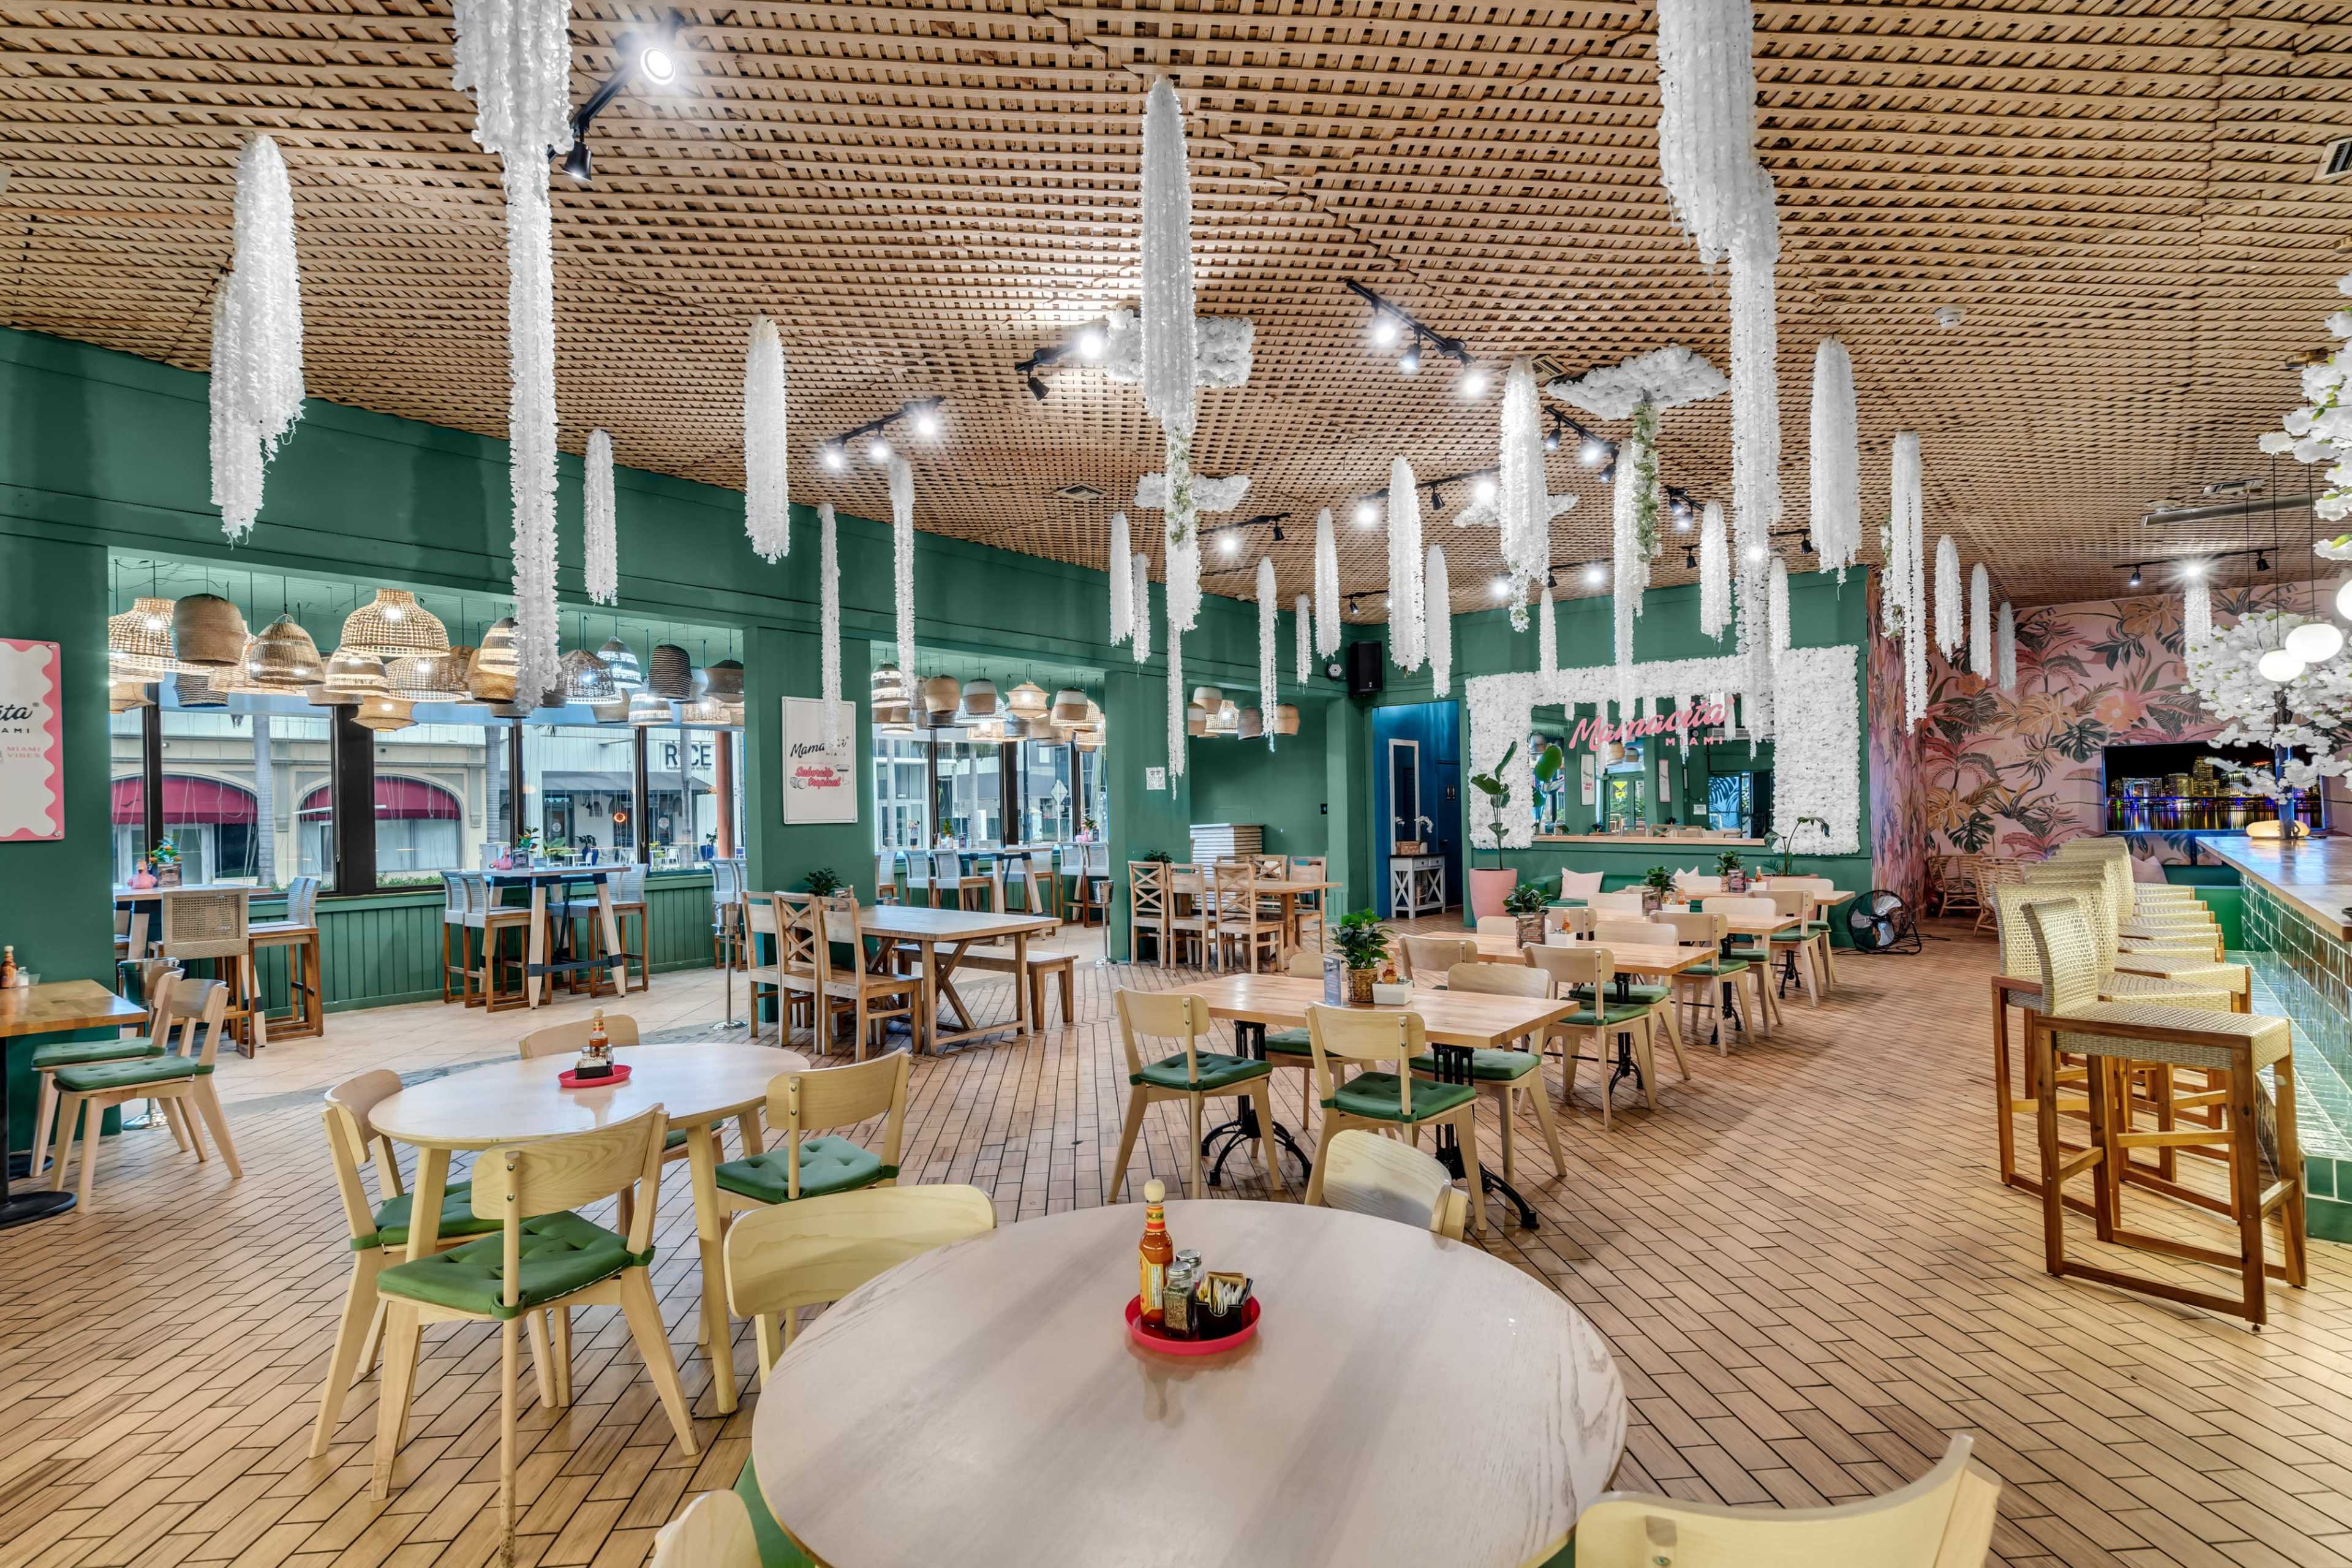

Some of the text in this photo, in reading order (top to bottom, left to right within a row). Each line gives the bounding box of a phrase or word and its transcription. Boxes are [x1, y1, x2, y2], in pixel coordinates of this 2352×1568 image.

[1569, 700, 1731, 752] Mamacita
[1665, 736, 1724, 746] MIAMI
[665, 744, 712, 766] RCE
